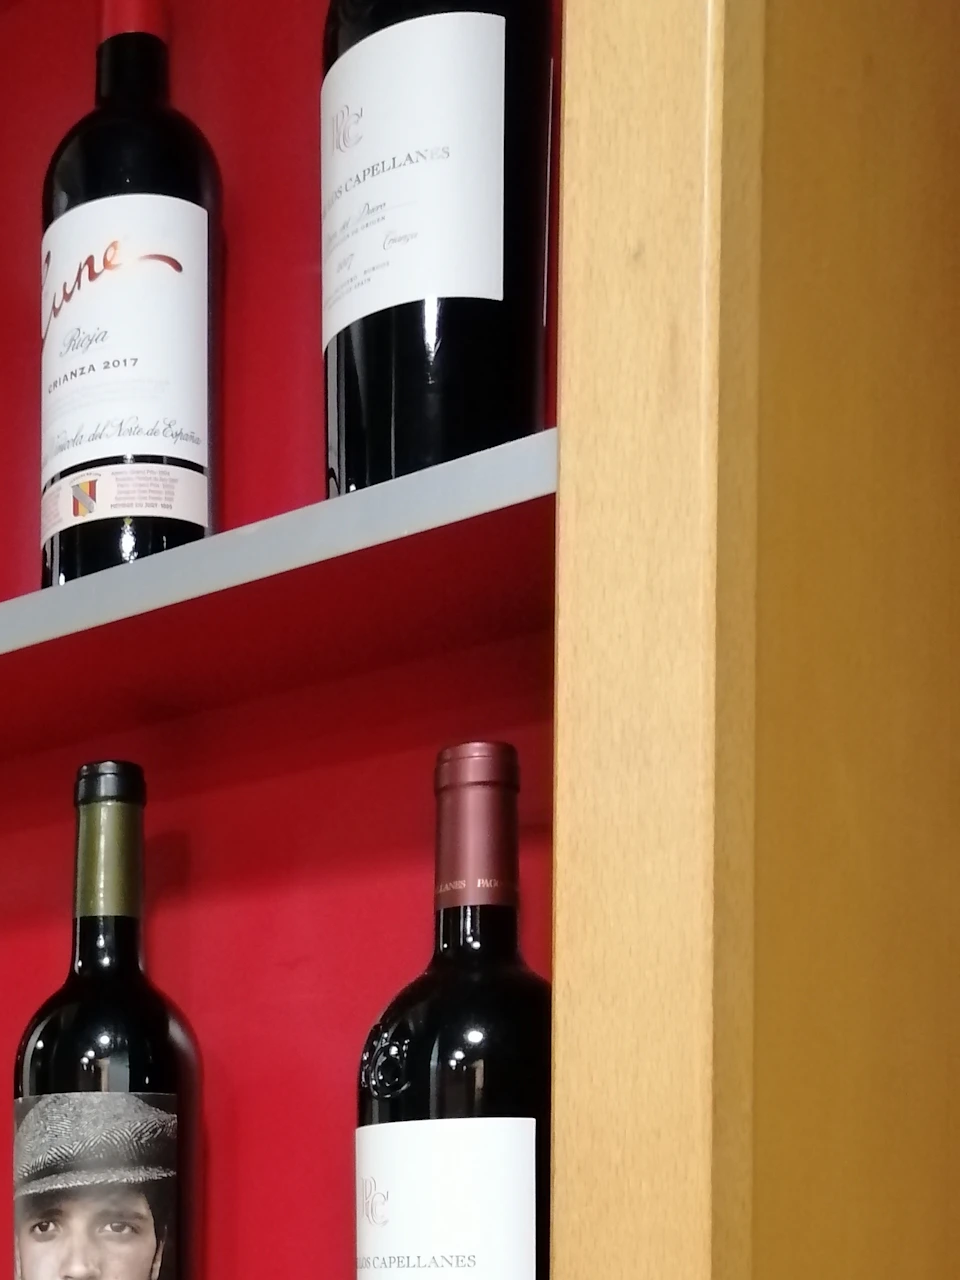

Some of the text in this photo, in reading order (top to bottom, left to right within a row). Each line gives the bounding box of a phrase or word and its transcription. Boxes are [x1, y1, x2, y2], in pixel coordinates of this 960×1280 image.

[344, 146, 450, 193] CAPELLANES
[59, 327, 109, 358] Rioja
[48, 357, 139, 395] CRIANZA 2017
[438, 879, 467, 893] LANES
[372, 1255, 477, 1269] CAPELLANES
